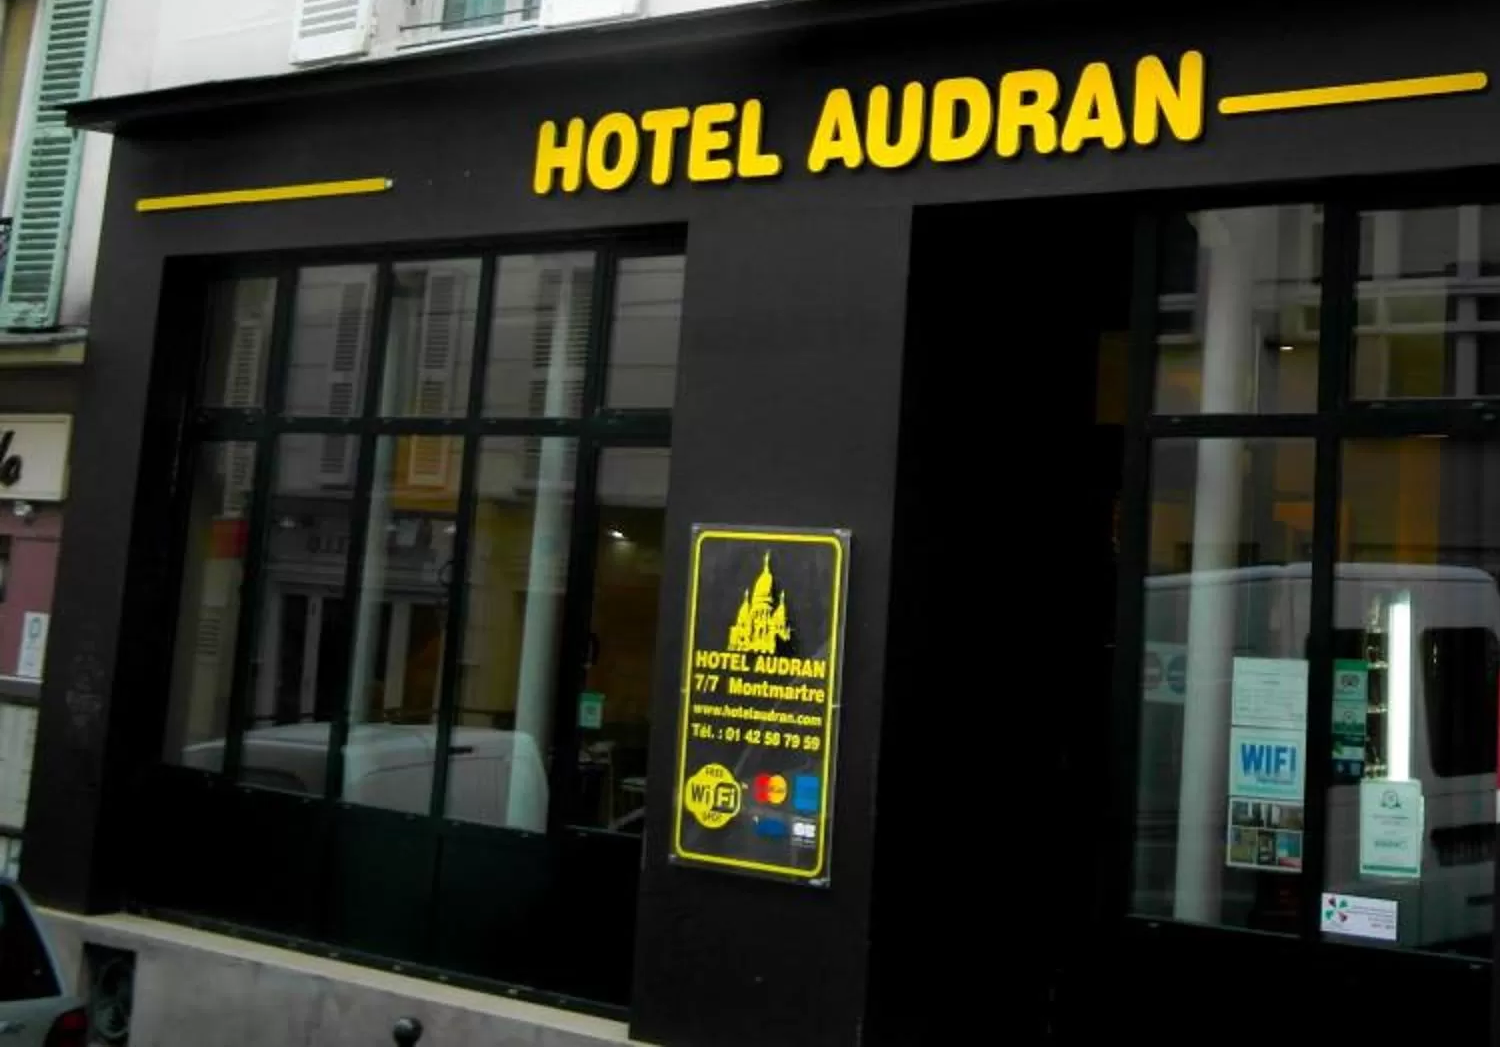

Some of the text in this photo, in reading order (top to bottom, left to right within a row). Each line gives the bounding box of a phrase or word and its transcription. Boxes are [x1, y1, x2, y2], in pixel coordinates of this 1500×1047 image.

[533, 50, 1204, 194] HOTEL AUDRAN
[695, 650, 827, 678] HOTEL AUDRAN
[694, 673, 825, 703] 7/7 Montmartre
[693, 703, 822, 726] www.hotelaudran.com
[725, 727, 741, 741] 01
[744, 729, 761, 744] 42
[1240, 742, 1297, 777] WIFI
